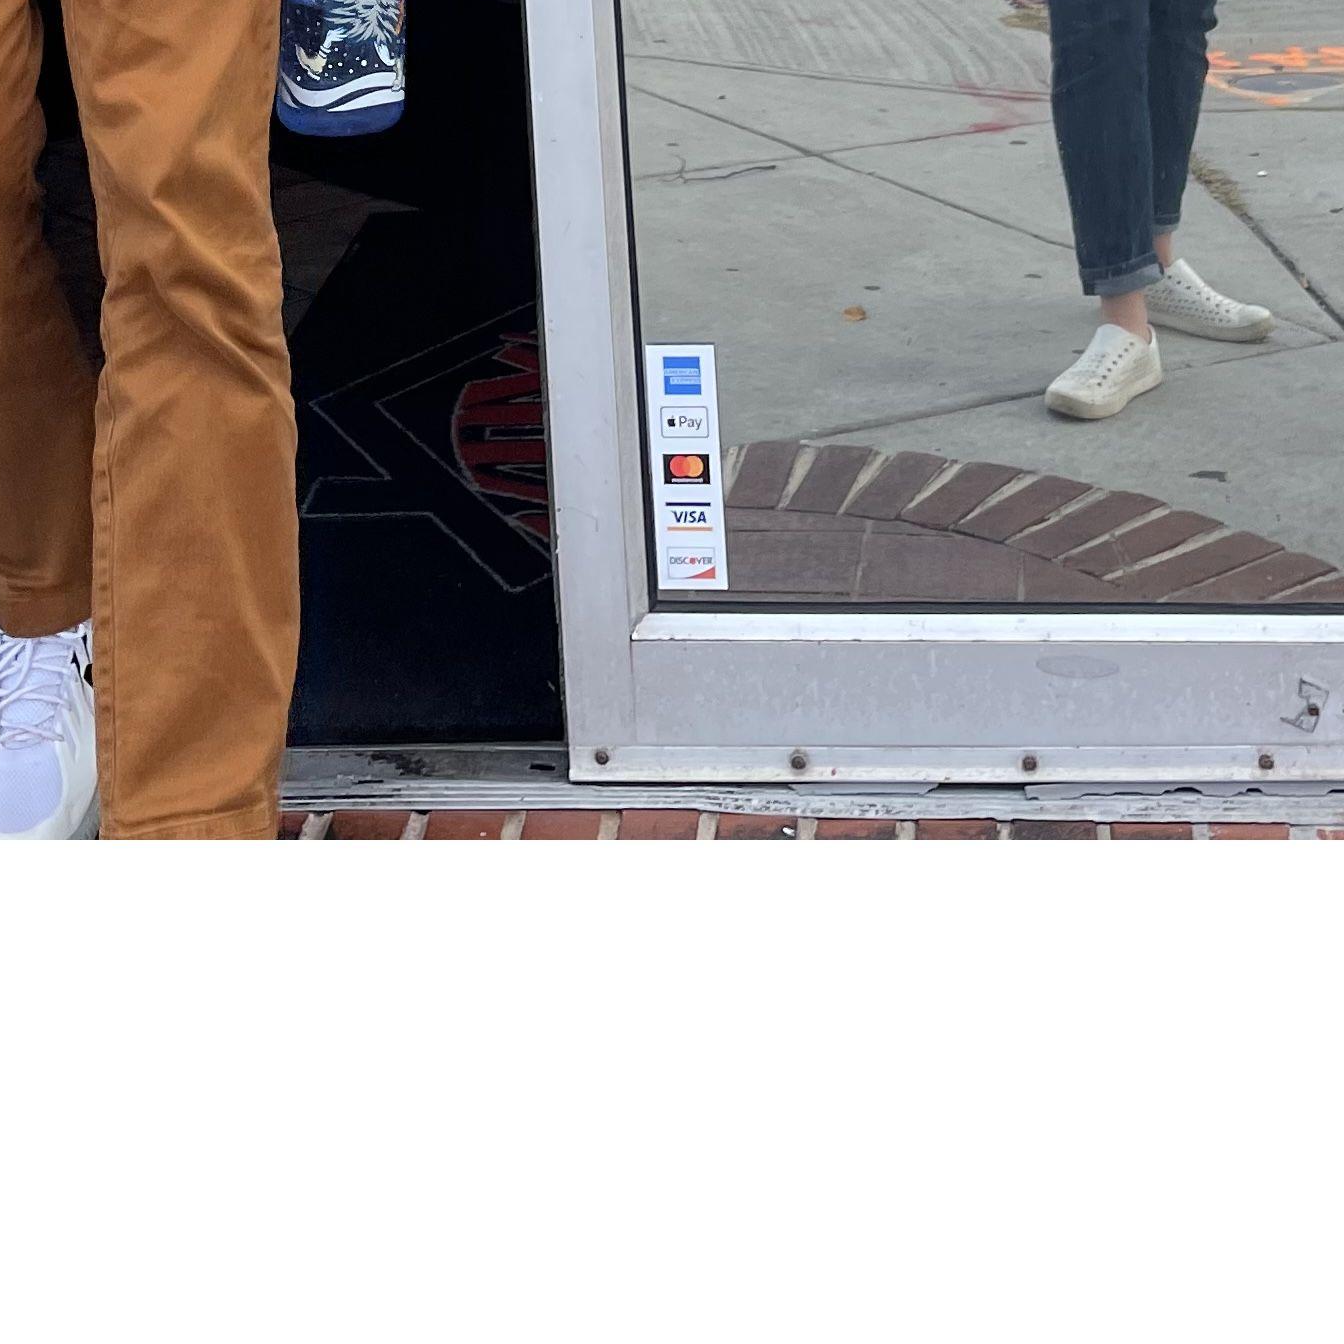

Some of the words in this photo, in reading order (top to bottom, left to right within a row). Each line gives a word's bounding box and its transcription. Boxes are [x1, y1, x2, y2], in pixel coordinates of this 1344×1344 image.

[679, 416, 703, 430] Pay
[671, 511, 707, 524] VISA
[669, 556, 713, 566] DISCOVER
